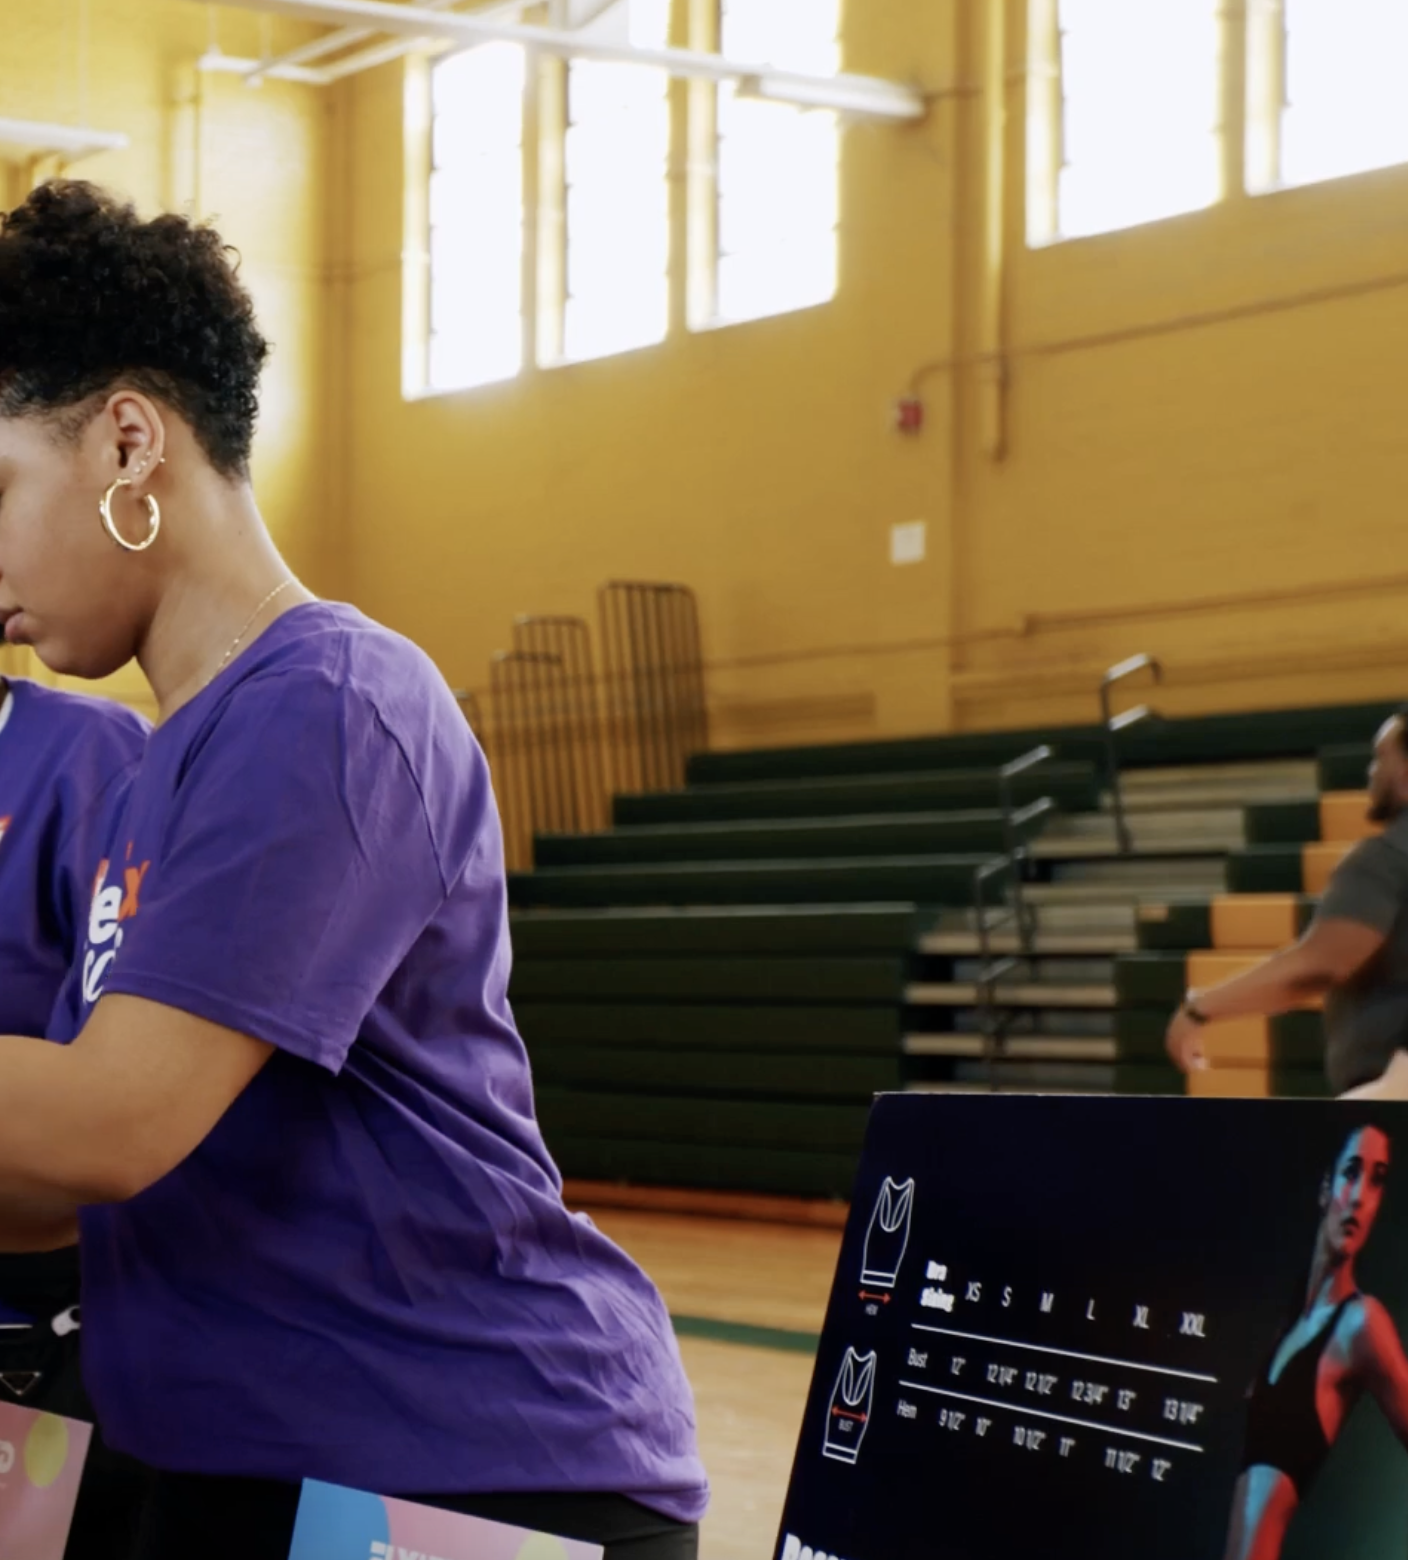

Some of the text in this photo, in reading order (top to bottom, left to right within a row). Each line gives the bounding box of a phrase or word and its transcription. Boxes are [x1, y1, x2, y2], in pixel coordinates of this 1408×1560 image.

[965, 1281, 982, 1302] XS
[1001, 1285, 1013, 1308] S
[1039, 1292, 1055, 1313] M
[1085, 1299, 1096, 1321] L
[1132, 1304, 1150, 1330] XL
[1179, 1311, 1206, 1337] XXL
[907, 1347, 929, 1369] Bust
[896, 1399, 918, 1420] Hem
